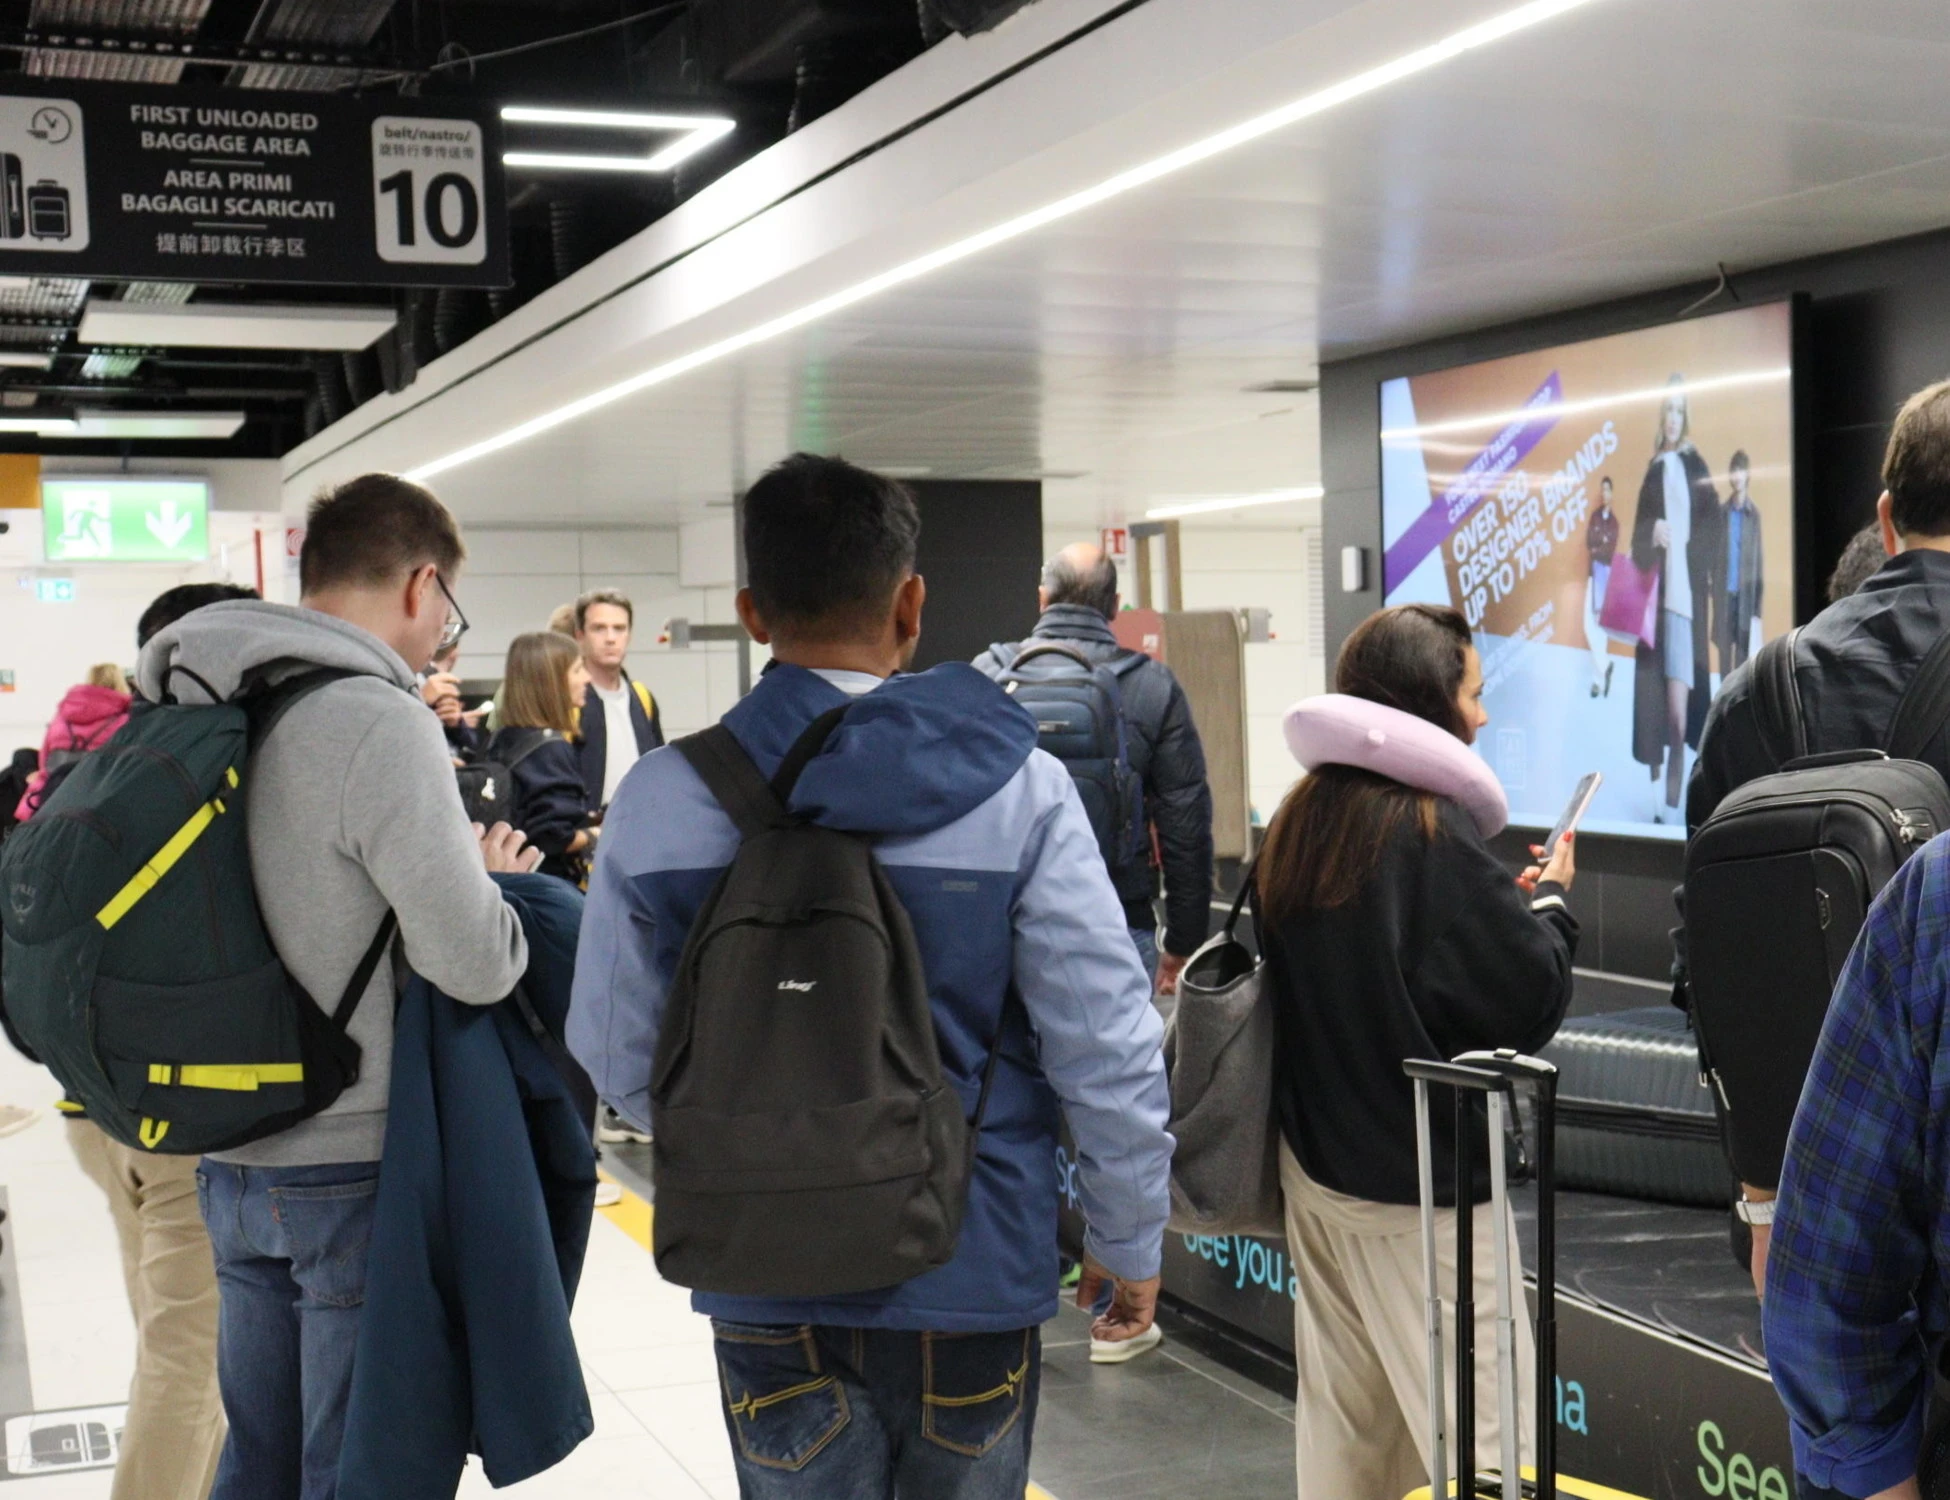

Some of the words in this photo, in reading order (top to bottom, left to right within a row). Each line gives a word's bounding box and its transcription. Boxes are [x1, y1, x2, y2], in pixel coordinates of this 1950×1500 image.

[130, 105, 191, 125] FIRST
[197, 109, 319, 131] UNLOADED
[141, 131, 247, 153] BAGGAGE
[252, 136, 311, 157] AREA
[121, 193, 218, 214] BAGAGLI
[224, 198, 335, 219] SCARICATI
[163, 170, 223, 189] AREA
[228, 172, 292, 192] PRIMI
[380, 170, 479, 248] 10
[1453, 501, 1498, 563] OVER
[1459, 497, 1542, 597] DESIGNER
[1542, 420, 1618, 514] BRANDS
[1464, 586, 1487, 627] UP
[1488, 563, 1514, 602] TO
[1514, 530, 1551, 580] 70%
[1553, 487, 1588, 542] OFF
[1234, 1235, 1282, 1293] you
[1697, 1420, 1788, 1500] See
